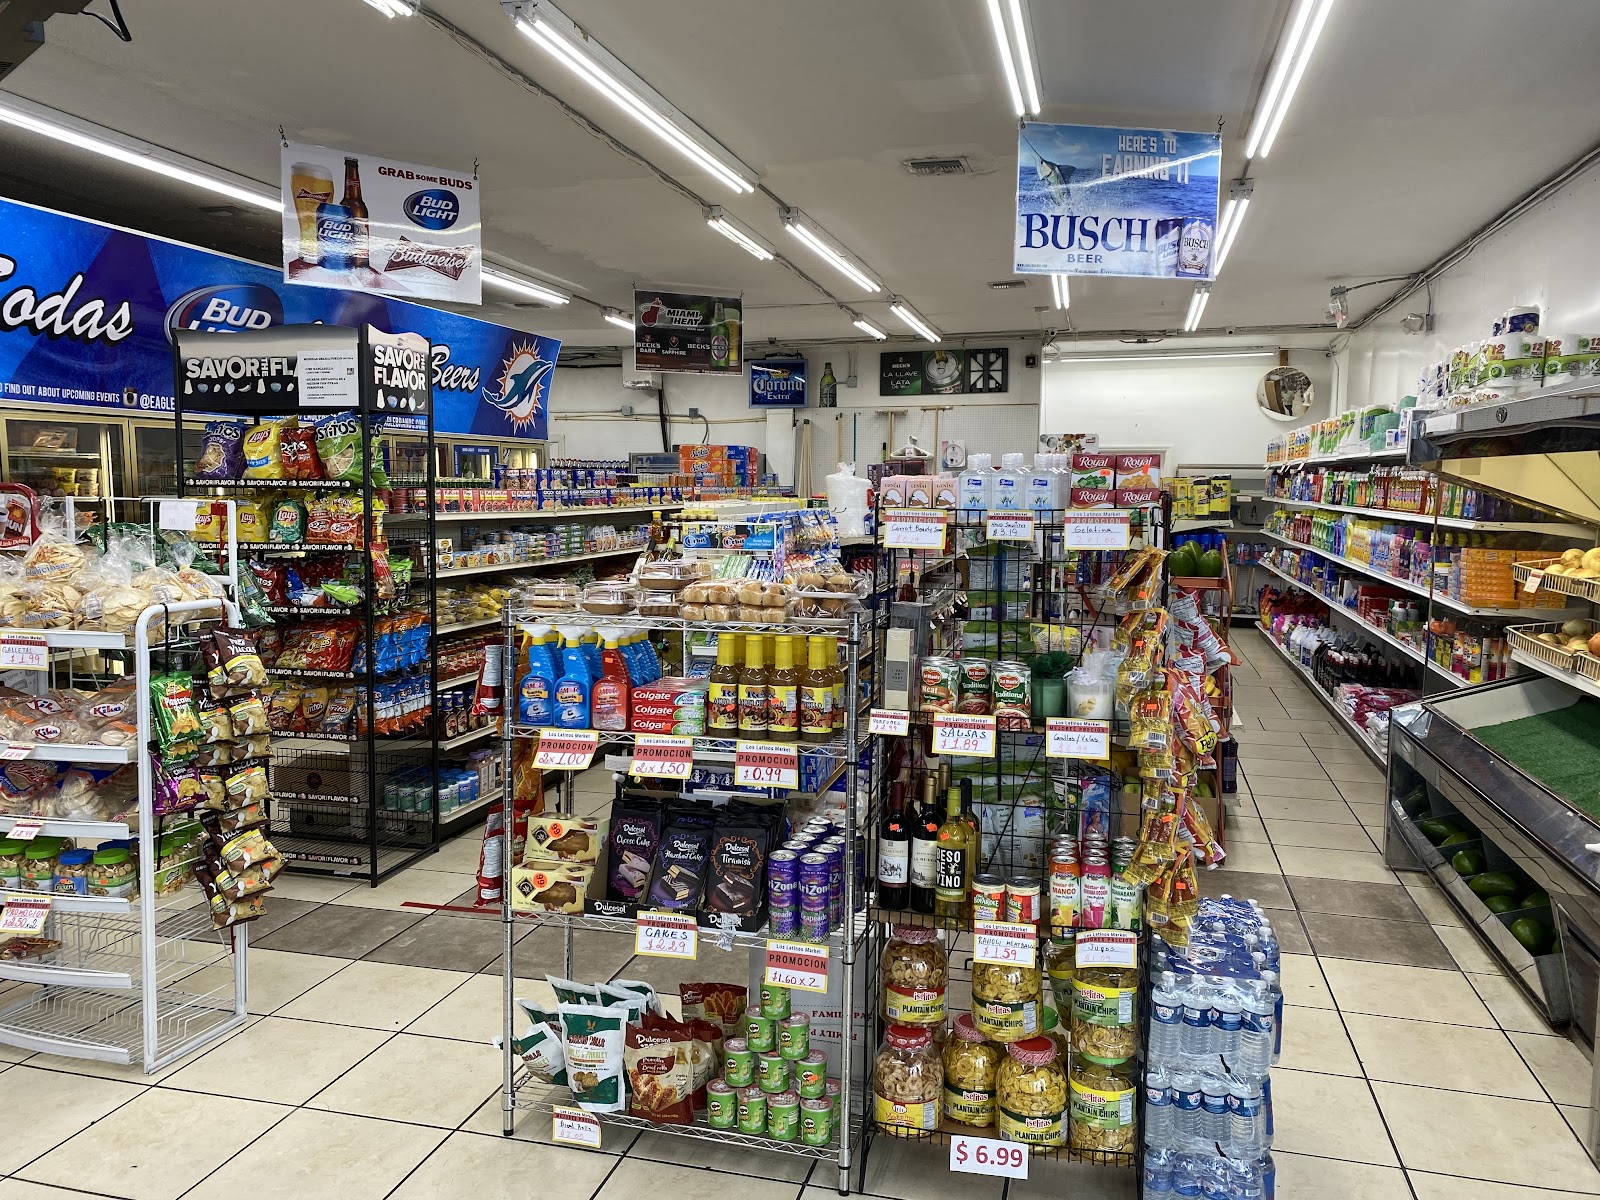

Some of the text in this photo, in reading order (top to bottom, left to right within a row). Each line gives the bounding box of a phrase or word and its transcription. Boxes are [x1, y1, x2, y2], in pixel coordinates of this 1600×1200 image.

[1118, 134, 1177, 154] HERE'S TO
[1101, 153, 1170, 181] EARNING
[378, 166, 472, 190] GRAB SOME BUDS
[419, 195, 454, 210] BUD
[412, 205, 457, 222] LIGHT
[321, 220, 352, 232] BUD
[1020, 212, 1152, 253] BUSCH
[1183, 236, 1210, 250] BUSCH
[391, 244, 472, 269] Budweiser
[1067, 254, 1103, 264] BEER
[201, 297, 272, 330] BUD
[667, 309, 700, 319] MIAMI
[673, 317, 701, 326] HEAT
[374, 344, 421, 370] SAVOR
[185, 356, 269, 379] SAVOR THE
[431, 344, 480, 391] Beers
[374, 365, 427, 391] FLAVOR
[4, 383, 20, 395] FIND
[21, 384, 36, 396] OUT
[37, 385, 61, 399] ABOUT
[61, 386, 95, 401] UPCOMING
[96, 388, 120, 403] EVENTS
[752, 377, 803, 396] Corona
[766, 393, 791, 401] Extra
[1078, 456, 1110, 469] Royal
[1122, 455, 1153, 469] Royal
[1078, 490, 1109, 504] Royal
[1122, 490, 1153, 503] Royal
[1074, 525, 1113, 534] Gelatina
[227, 643, 256, 655] Yucas
[633, 690, 671, 702] Colgate
[994, 689, 1025, 700] Traditional
[634, 704, 673, 716] Colgate
[943, 721, 986, 730] PROMOCION
[941, 727, 987, 739] SALSAS
[540, 740, 594, 751] PROMOCION
[941, 738, 979, 751] $ 1.89
[636, 748, 692, 758] PROMOCION
[738, 754, 796, 766] PROMOCION
[656, 762, 686, 775] 1.50
[744, 767, 782, 782] $ 0.99
[622, 823, 647, 836] Dulcesol
[673, 840, 699, 852] Dulcesol
[724, 842, 751, 855] Dulcesol
[936, 849, 961, 864] BESO
[1052, 886, 1077, 896] MANGO
[594, 902, 627, 915] Dulcesol
[647, 920, 688, 931] PROMOCION
[645, 927, 688, 940] CAKES
[984, 929, 1027, 939] PROMOCION
[645, 939, 653, 950] $
[785, 944, 805, 952] Latinos
[805, 946, 822, 954] Market
[983, 946, 1018, 961] $ 1.59
[768, 954, 827, 970] PROMOCION
[771, 970, 798, 985] $1.60
[807, 977, 818, 988] 2
[913, 990, 938, 1002] iselitas
[1080, 987, 1106, 1000] iselitas
[902, 1003, 945, 1015] PLANTAIN CHIPS
[986, 1002, 1013, 1015] iselitas
[1097, 1005, 1118, 1016] CHIPS
[979, 1014, 1024, 1028] PLANTAIN CHIPS
[962, 1091, 989, 1102] iselitas
[1080, 1090, 1107, 1104] iselitas
[952, 1101, 996, 1114] PLANTAIN CHIPS
[1072, 1100, 1119, 1119] PLANTAIN CHIPS
[1025, 1117, 1052, 1129] iselitas
[1014, 1129, 1061, 1141] PLANTAIN CHIPS
[956, 1140, 1024, 1168] $ 6.99
